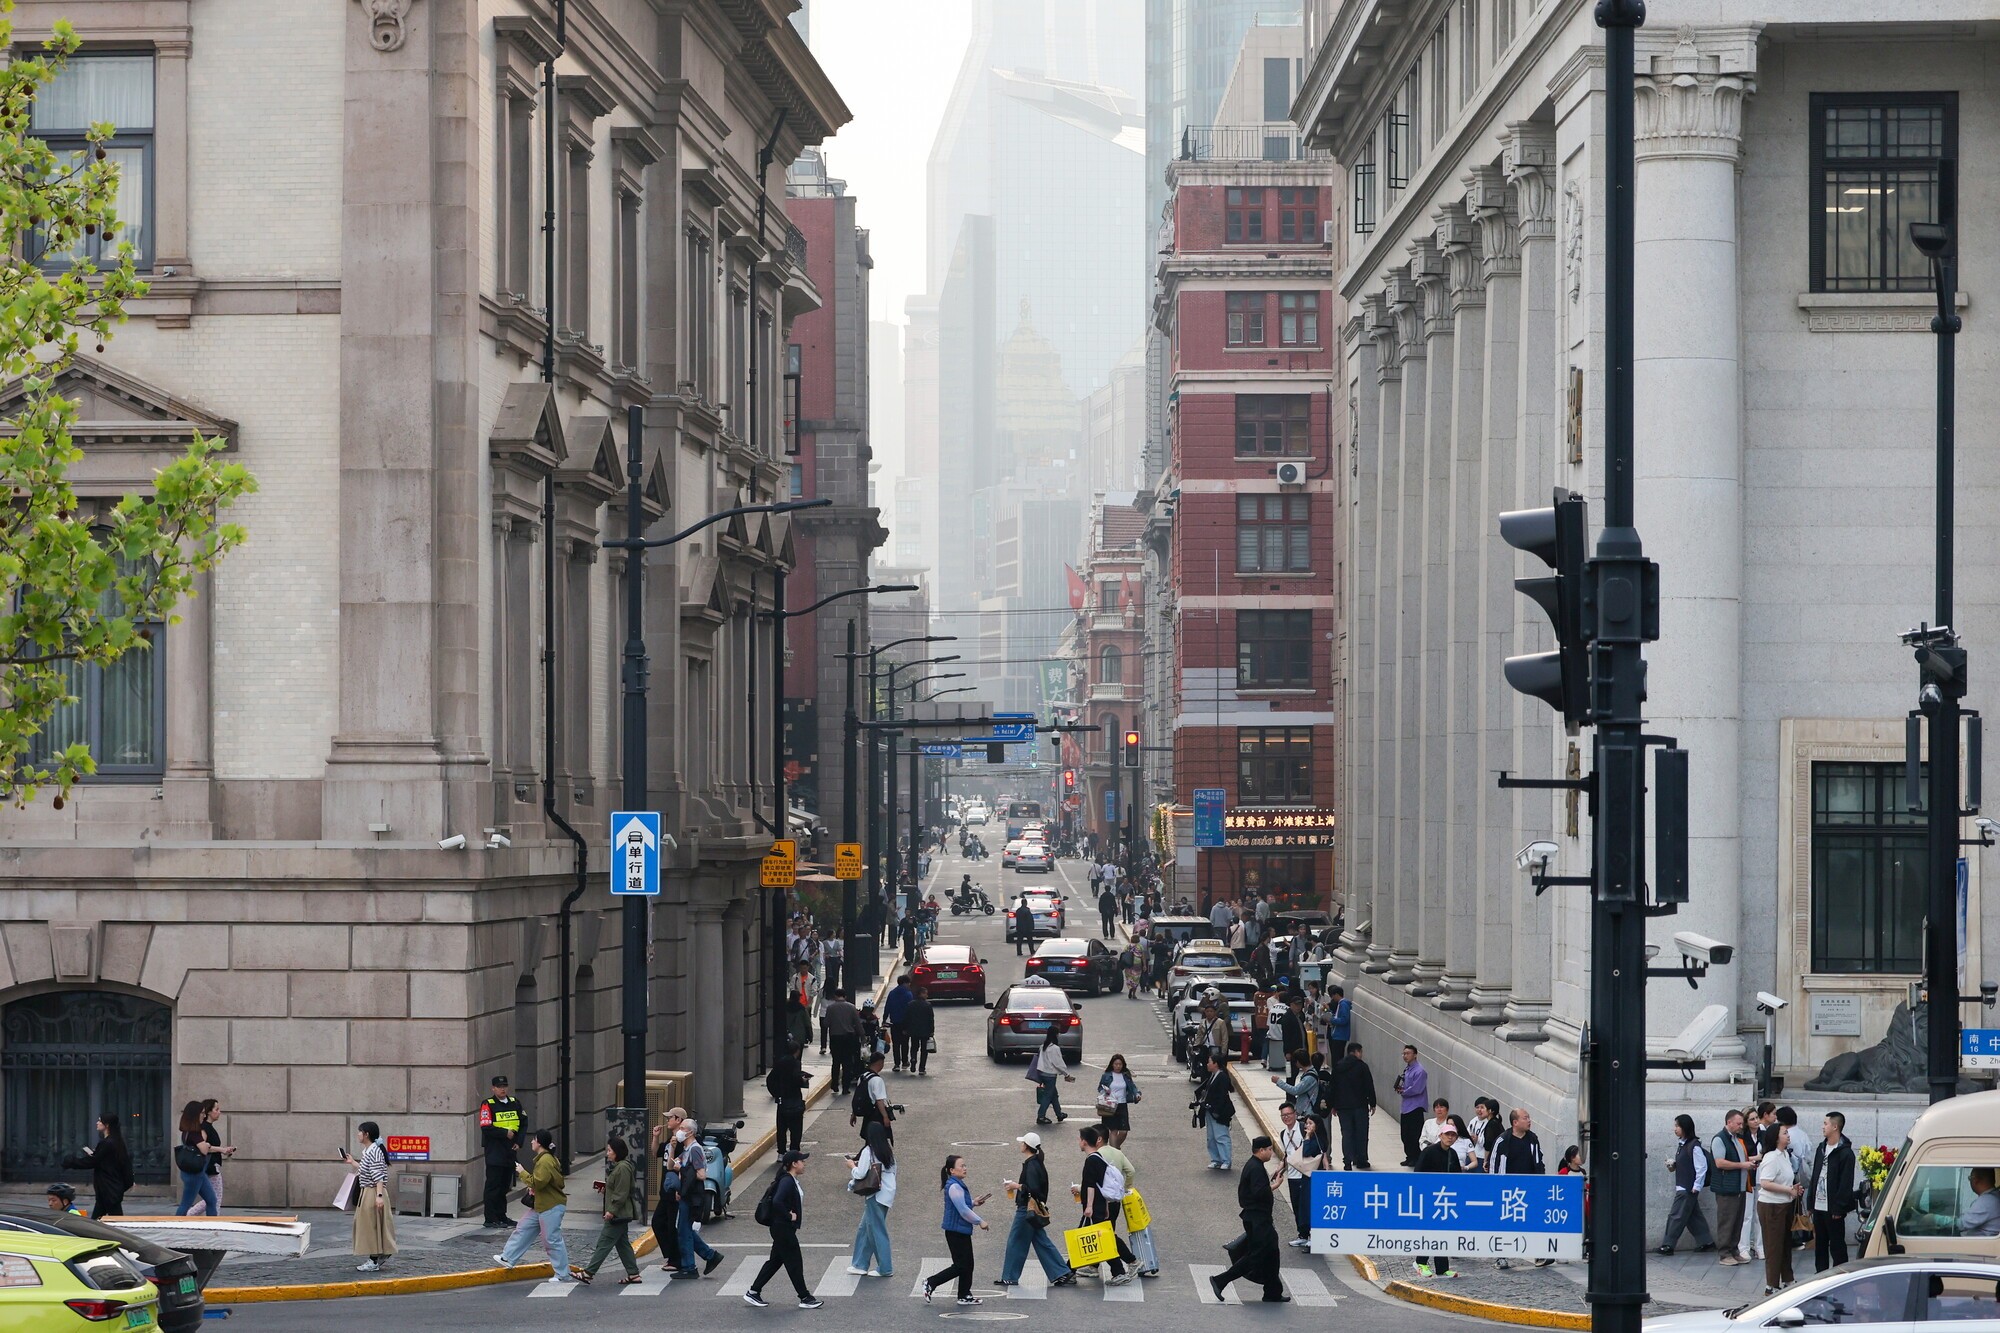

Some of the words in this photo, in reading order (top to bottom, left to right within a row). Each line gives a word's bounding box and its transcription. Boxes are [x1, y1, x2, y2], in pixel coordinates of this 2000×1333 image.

[629, 846, 642, 888] 单行道
[1969, 1034, 1979, 1044] 南
[1989, 1036, 2000, 1051] 中
[1971, 1057, 1978, 1065] S
[1327, 1181, 1343, 1198] 南
[1364, 1183, 1529, 1222] 中山东一路
[1548, 1185, 1564, 1201] 北
[1323, 1205, 1347, 1220] 287
[1544, 1209, 1568, 1225] 309
[1080, 1234, 1097, 1245] TOP
[1082, 1243, 1098, 1254] TOY
[1330, 1233, 1339, 1248] S
[1367, 1234, 1448, 1252] Zhongshan
[1458, 1236, 1480, 1252] Rd.
[1488, 1235, 1528, 1253] (E-1)
[1548, 1238, 1558, 1253] N
